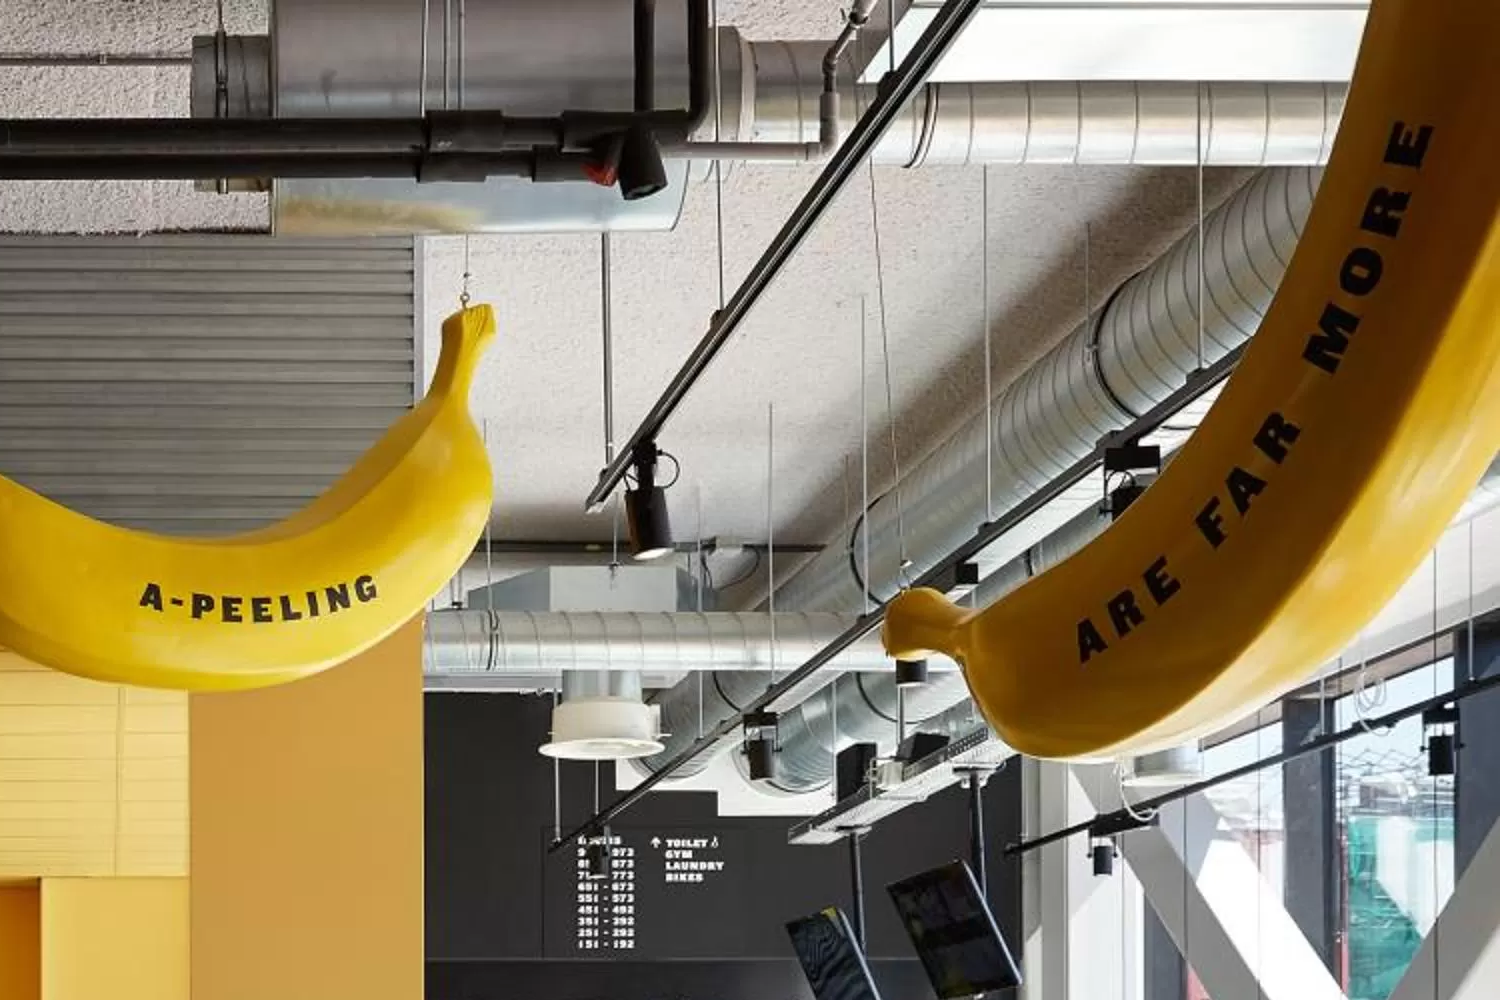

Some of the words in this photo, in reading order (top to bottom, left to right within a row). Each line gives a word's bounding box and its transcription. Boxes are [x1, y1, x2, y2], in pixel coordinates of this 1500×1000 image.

[1077, 555, 1181, 663] ARE
[1195, 412, 1301, 549] FAR
[1302, 121, 1435, 374] MORE
[139, 575, 377, 623] A-PEELING
[665, 838, 709, 848] TOILET
[665, 849, 693, 859] GYM
[665, 861, 725, 871] LAUNDRY
[612, 893, 635, 903] 573
[612, 939, 635, 949] 192
